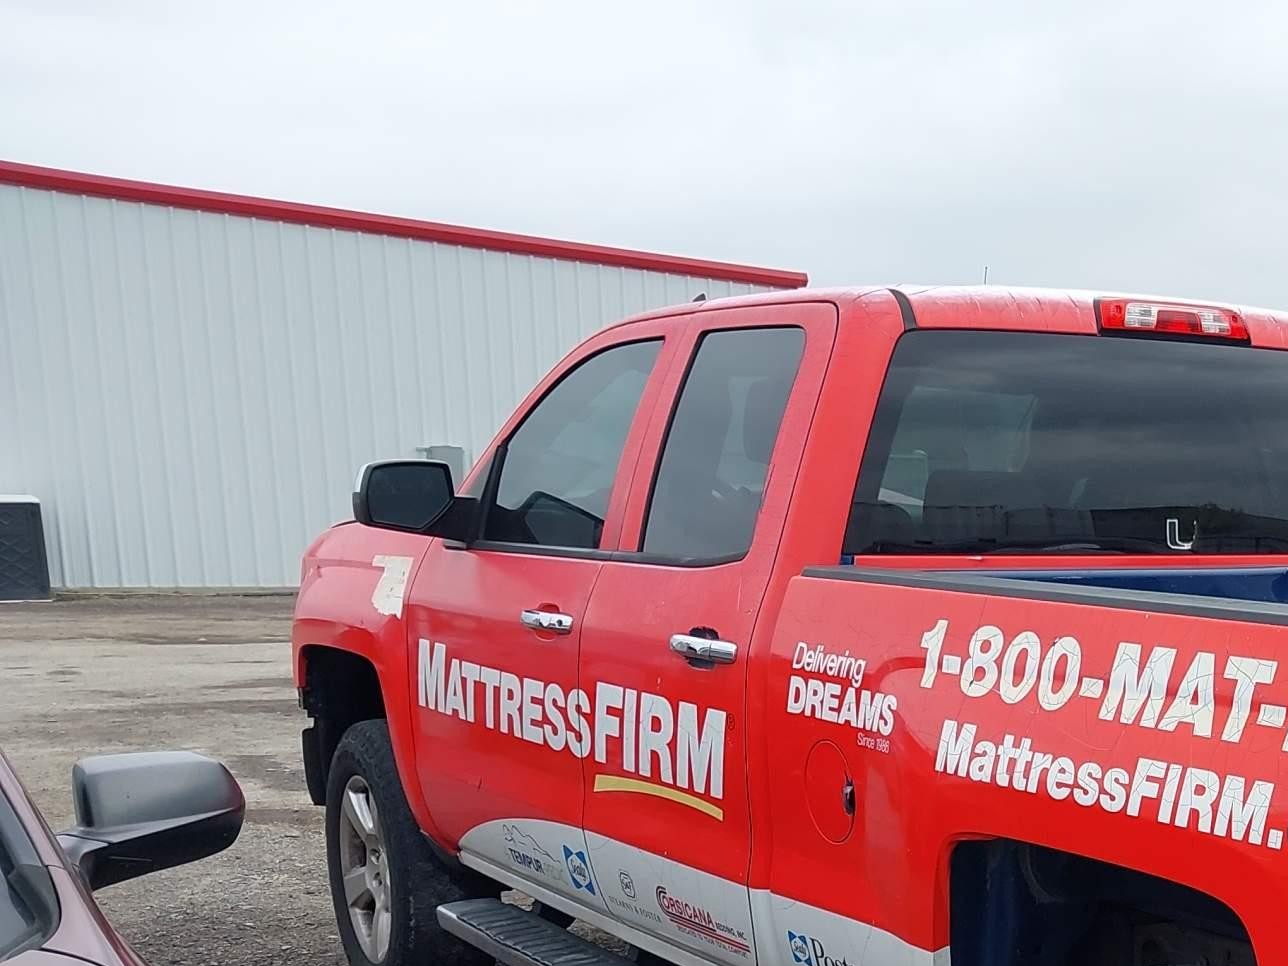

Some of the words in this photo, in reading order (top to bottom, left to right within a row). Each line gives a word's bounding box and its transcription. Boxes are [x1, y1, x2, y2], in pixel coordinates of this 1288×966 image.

[792, 641, 867, 688] Delivering
[787, 675, 898, 736] DREAMS
[856, 732, 875, 750] Since
[656, 885, 716, 932] CORSICANA
